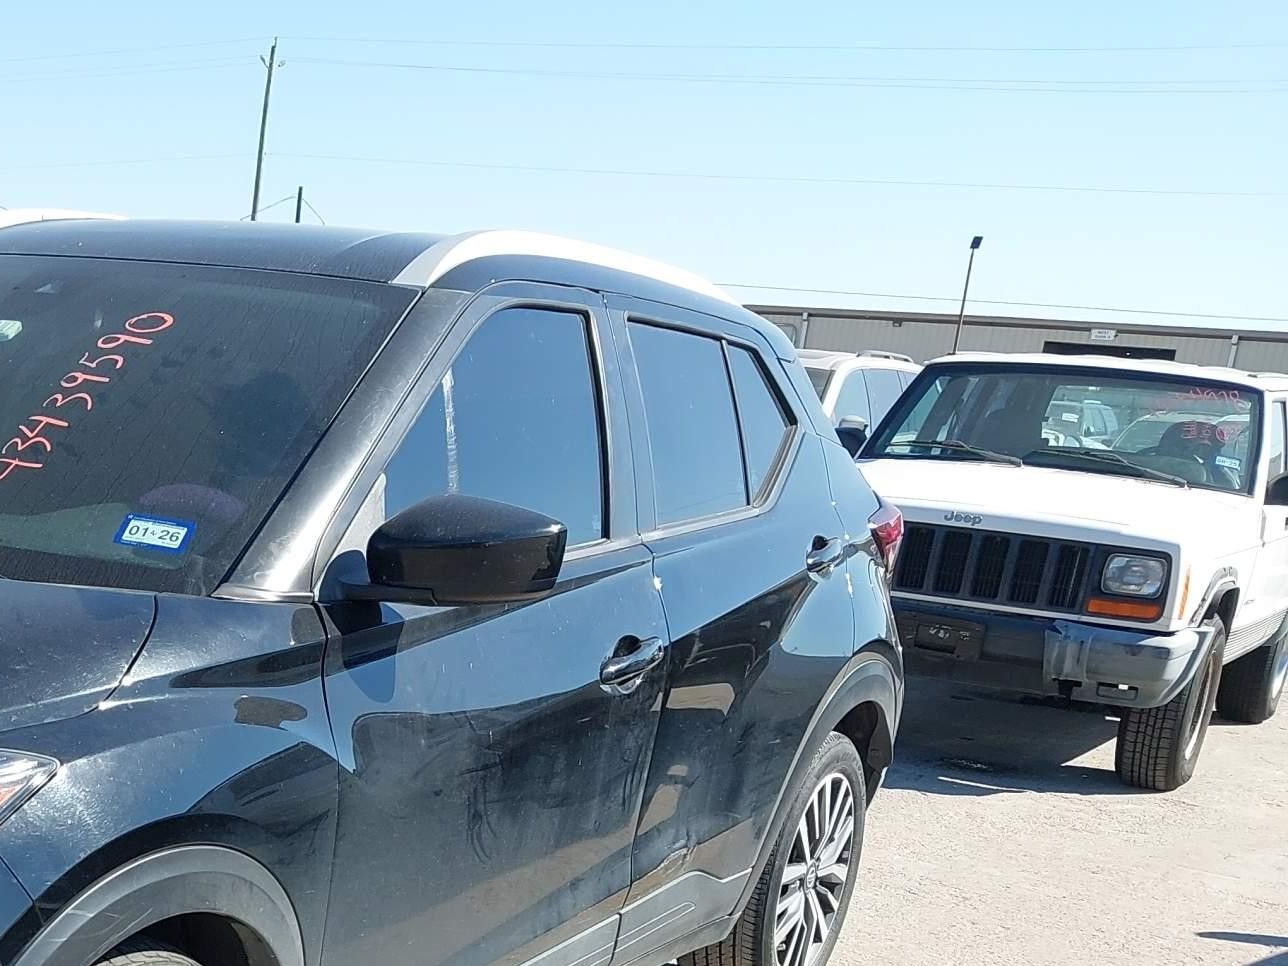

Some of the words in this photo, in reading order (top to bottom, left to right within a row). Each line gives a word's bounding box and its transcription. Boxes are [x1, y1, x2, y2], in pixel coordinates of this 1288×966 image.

[943, 511, 983, 526] Jeep
[128, 525, 150, 537] 01
[157, 529, 181, 542] 26
